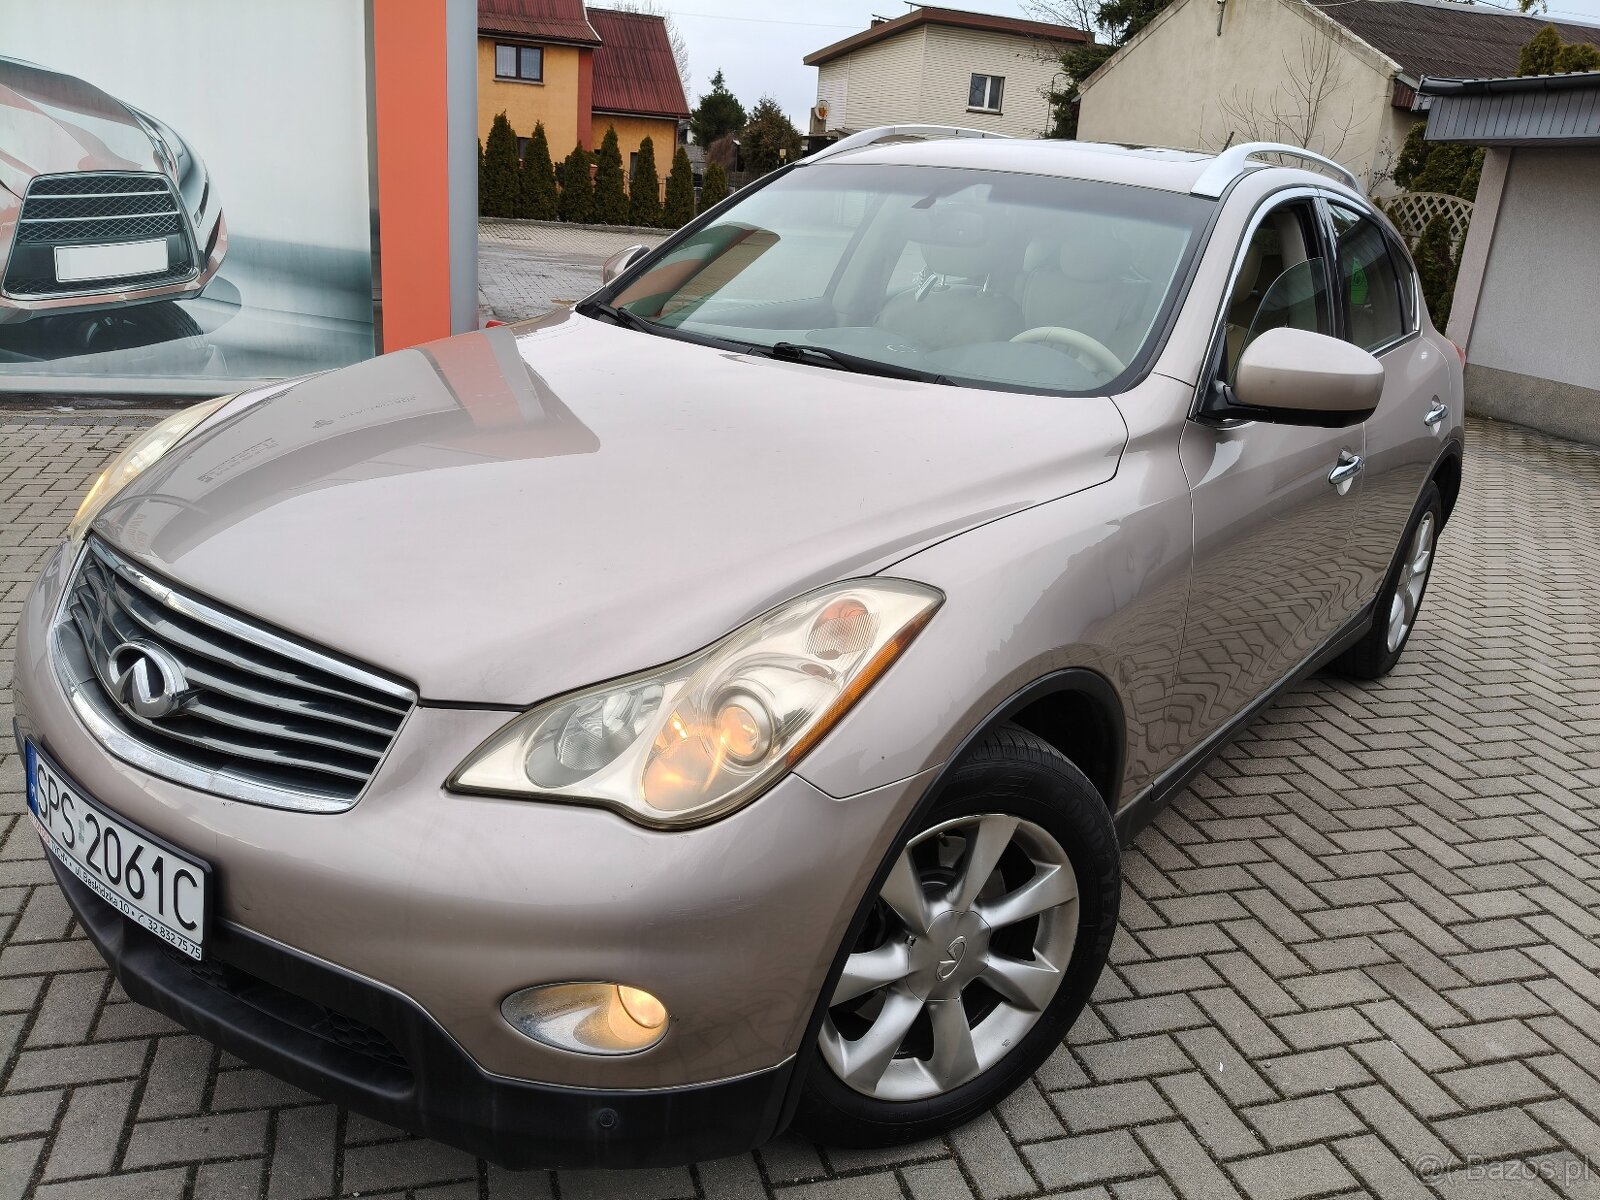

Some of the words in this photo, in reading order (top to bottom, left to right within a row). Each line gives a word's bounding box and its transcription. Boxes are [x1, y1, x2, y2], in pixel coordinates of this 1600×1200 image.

[38, 764, 76, 850] SPS
[85, 812, 199, 931] 2061C
[119, 900, 130, 915] 10
[148, 918, 159, 934] 32
[160, 927, 176, 946] 832
[177, 940, 188, 952] 75
[190, 945, 202, 960] 75
